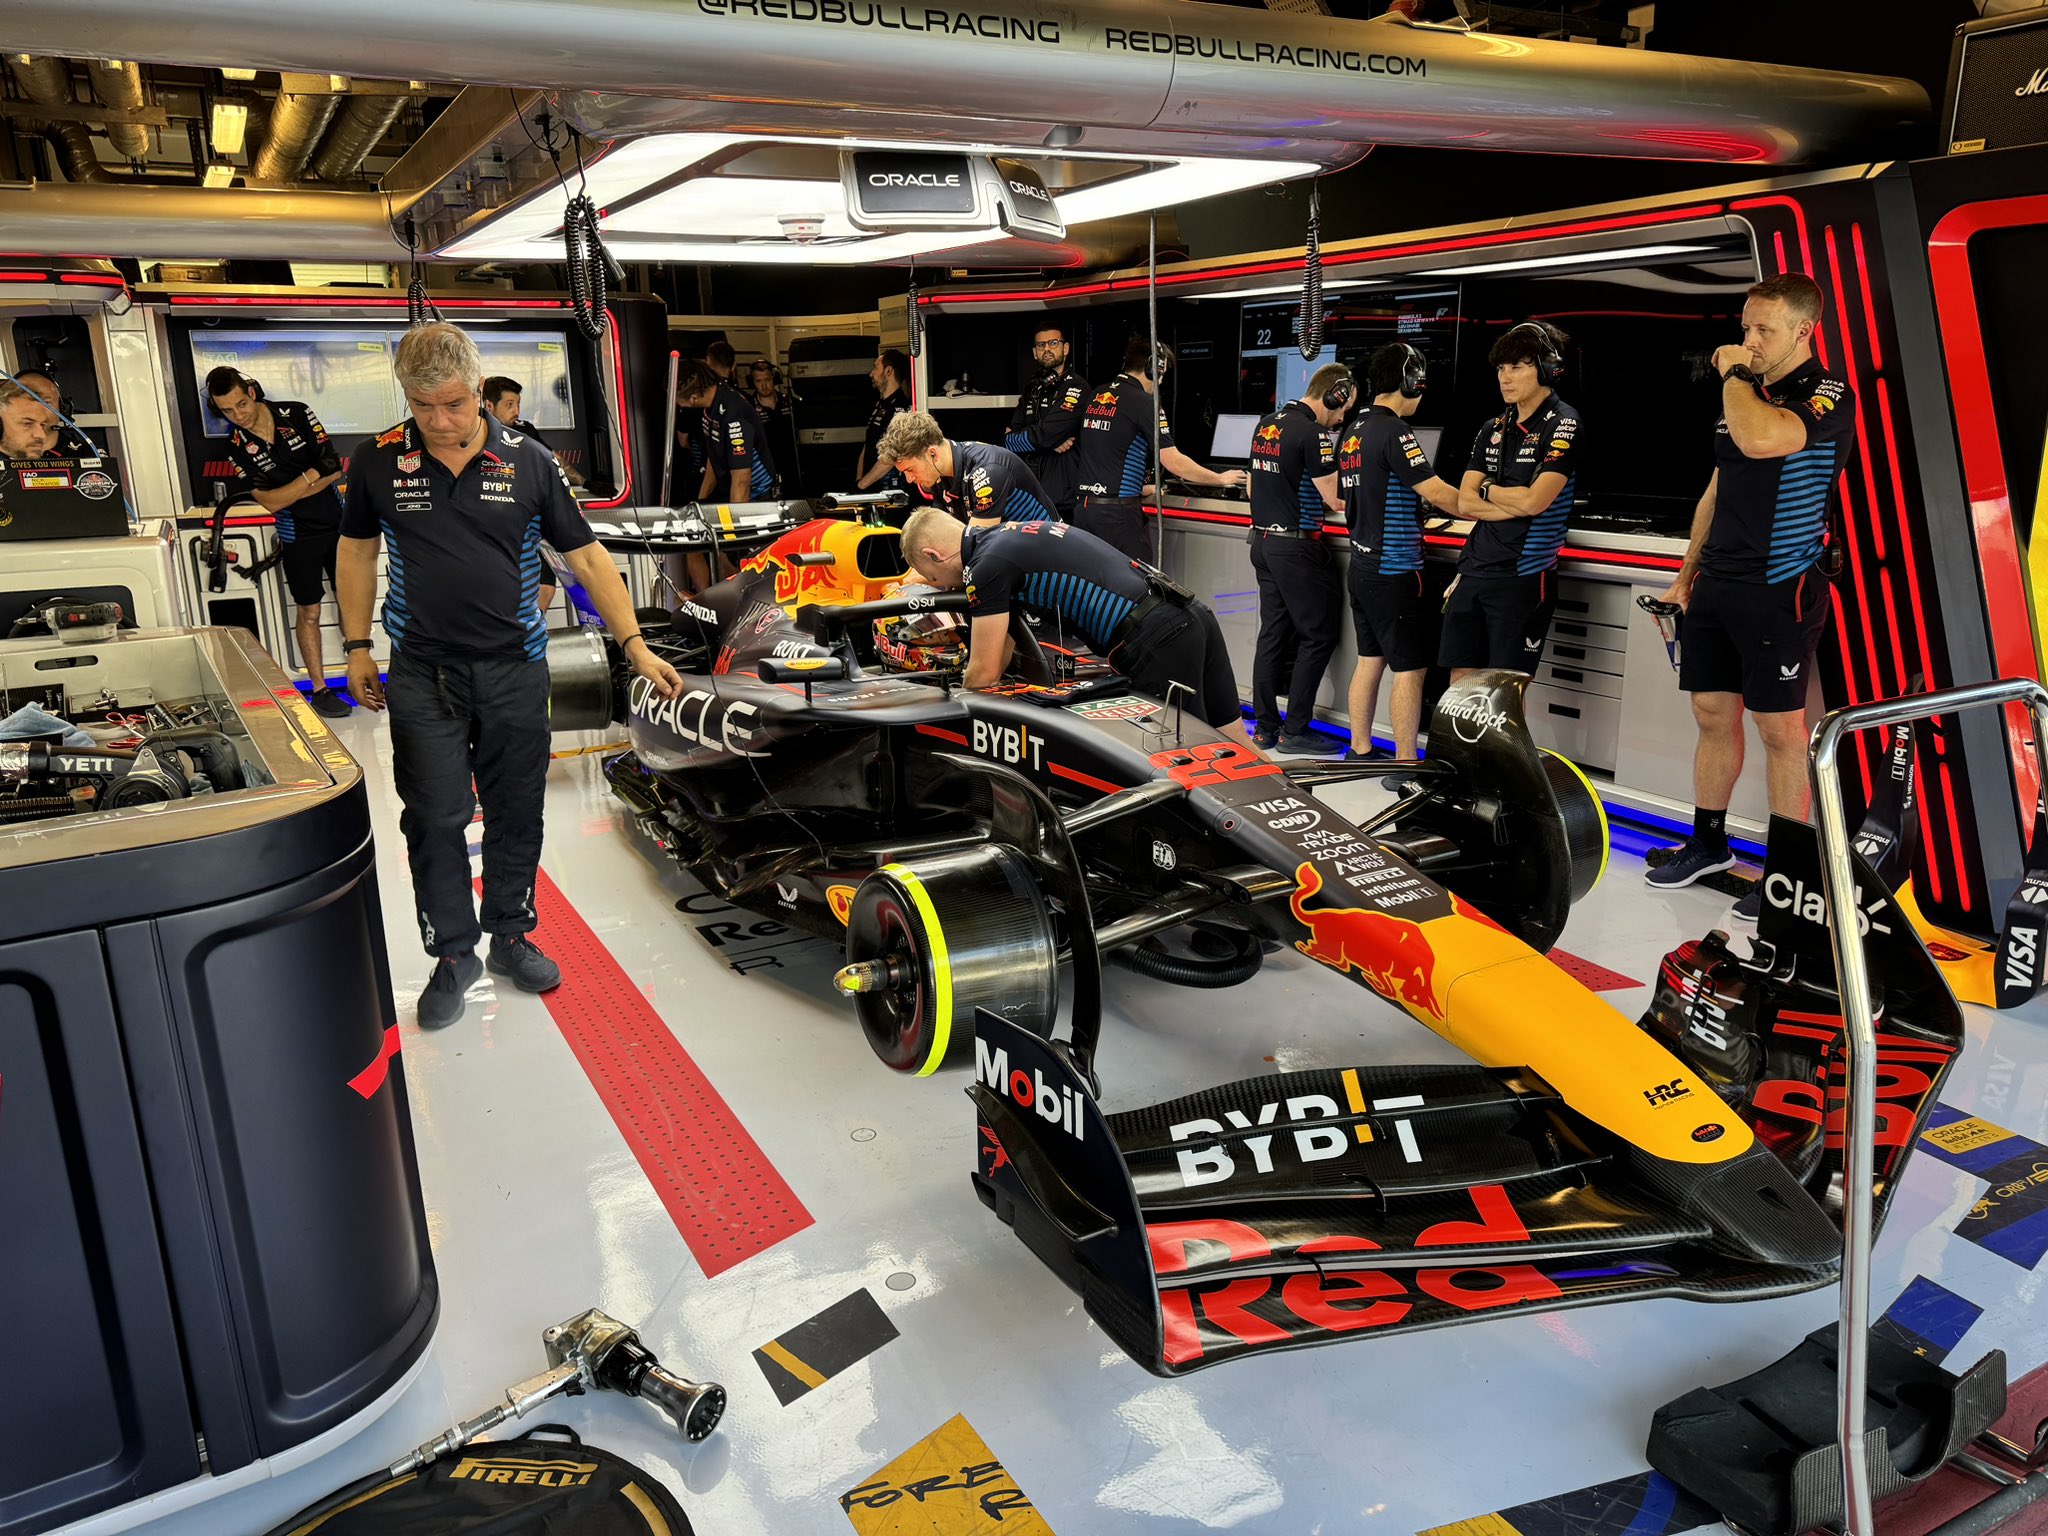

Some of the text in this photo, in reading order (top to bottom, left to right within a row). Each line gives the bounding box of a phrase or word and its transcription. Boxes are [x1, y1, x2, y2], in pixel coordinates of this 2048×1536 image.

[1105, 28, 1426, 77] REDBULLRACING.COM
[868, 174, 960, 187] ORACLE
[1009, 180, 1049, 202] ORACLE
[1257, 329, 1271, 345] 22
[1814, 389, 1841, 401] ROKT
[1086, 404, 1099, 416] Red
[1099, 406, 1117, 418] Bull
[1083, 419, 1101, 430] Mobil
[1553, 432, 1575, 440] ROKT
[1252, 441, 1280, 456] Red Bull
[11, 461, 31, 469] GIVES
[51, 460, 74, 468] WINGS
[393, 479, 419, 488] Mobil
[482, 481, 512, 492] BYBIT
[480, 494, 515, 503] HONDA
[681, 600, 718, 625] HONDA
[773, 640, 815, 658] ROKT
[881, 635, 907, 661] Bull
[1075, 697, 1141, 711] TAG
[1083, 703, 1157, 718] HEUER
[629, 674, 772, 757] ORACLE
[1440, 698, 1507, 732] Hard Rock
[973, 719, 1045, 771] BYBIT
[1894, 725, 1910, 766] Mobil
[59, 757, 113, 773] YETI
[1148, 742, 1284, 790] 22
[1245, 797, 1307, 815] VISA
[1268, 813, 1311, 830] CDW
[1297, 833, 1355, 850] TRADE
[1303, 830, 1335, 842] AVA
[1152, 840, 1176, 870] FIA
[1310, 842, 1371, 861] zoom
[1347, 852, 1384, 865] ARCTIC
[1357, 861, 1386, 871] WOLF
[1345, 867, 1407, 887] PIRELLI
[1361, 878, 1421, 897] infinitum
[778, 900, 797, 910] CASTORE
[1374, 890, 1421, 909] Mobil
[1765, 872, 1870, 937] Clao
[2005, 926, 2038, 991] VISA
[975, 1036, 1084, 1141] Mobil
[1643, 1078, 1691, 1107] HRC
[1169, 1068, 1426, 1188] BYBIT
[1932, 1122, 1978, 1139] ORACLE
[1954, 1133, 1999, 1149] RACING
[1145, 1184, 1561, 1365] Red
[449, 1457, 599, 1487] PIRELLI
